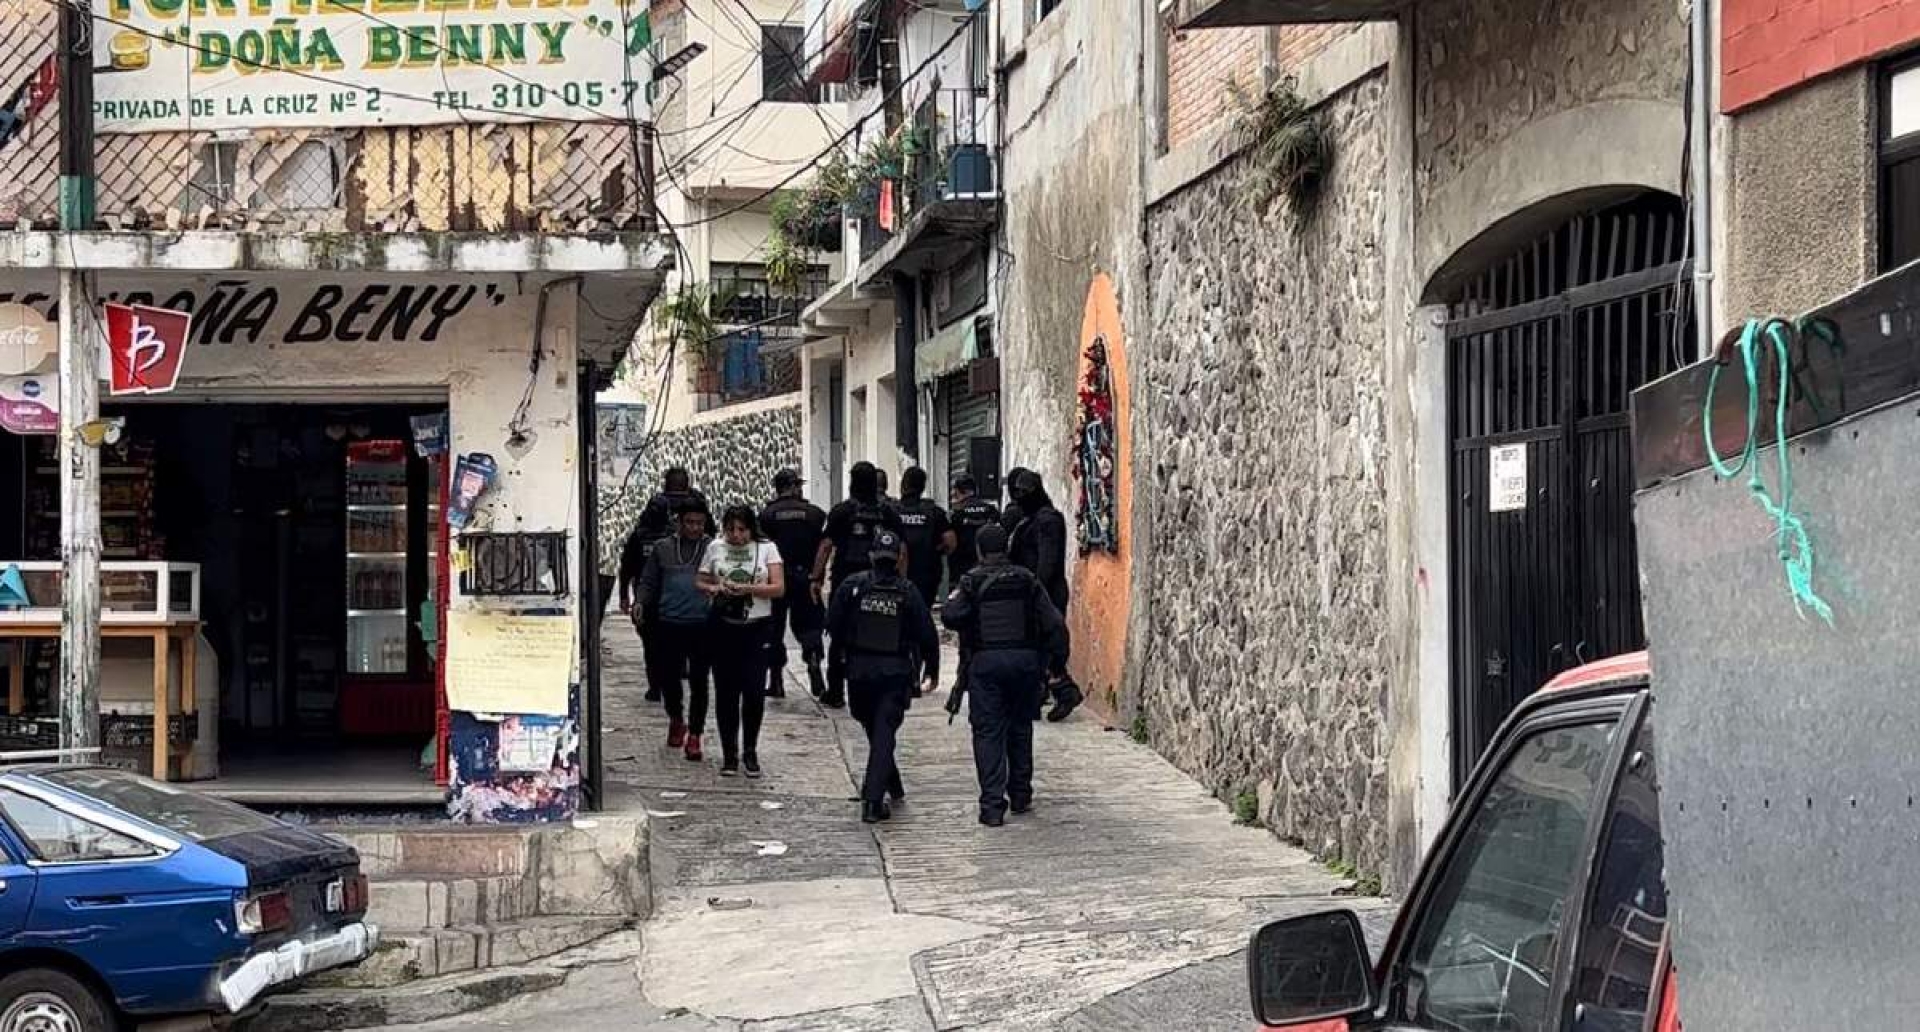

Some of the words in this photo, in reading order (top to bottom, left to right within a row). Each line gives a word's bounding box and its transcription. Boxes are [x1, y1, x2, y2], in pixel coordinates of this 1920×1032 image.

[91, 98, 181, 119] PRIVADA
[191, 98, 214, 118] DE
[226, 96, 254, 116] LA
[263, 93, 318, 115] CRUZ
[366, 87, 381, 112] 2
[432, 90, 483, 110] TEL.
